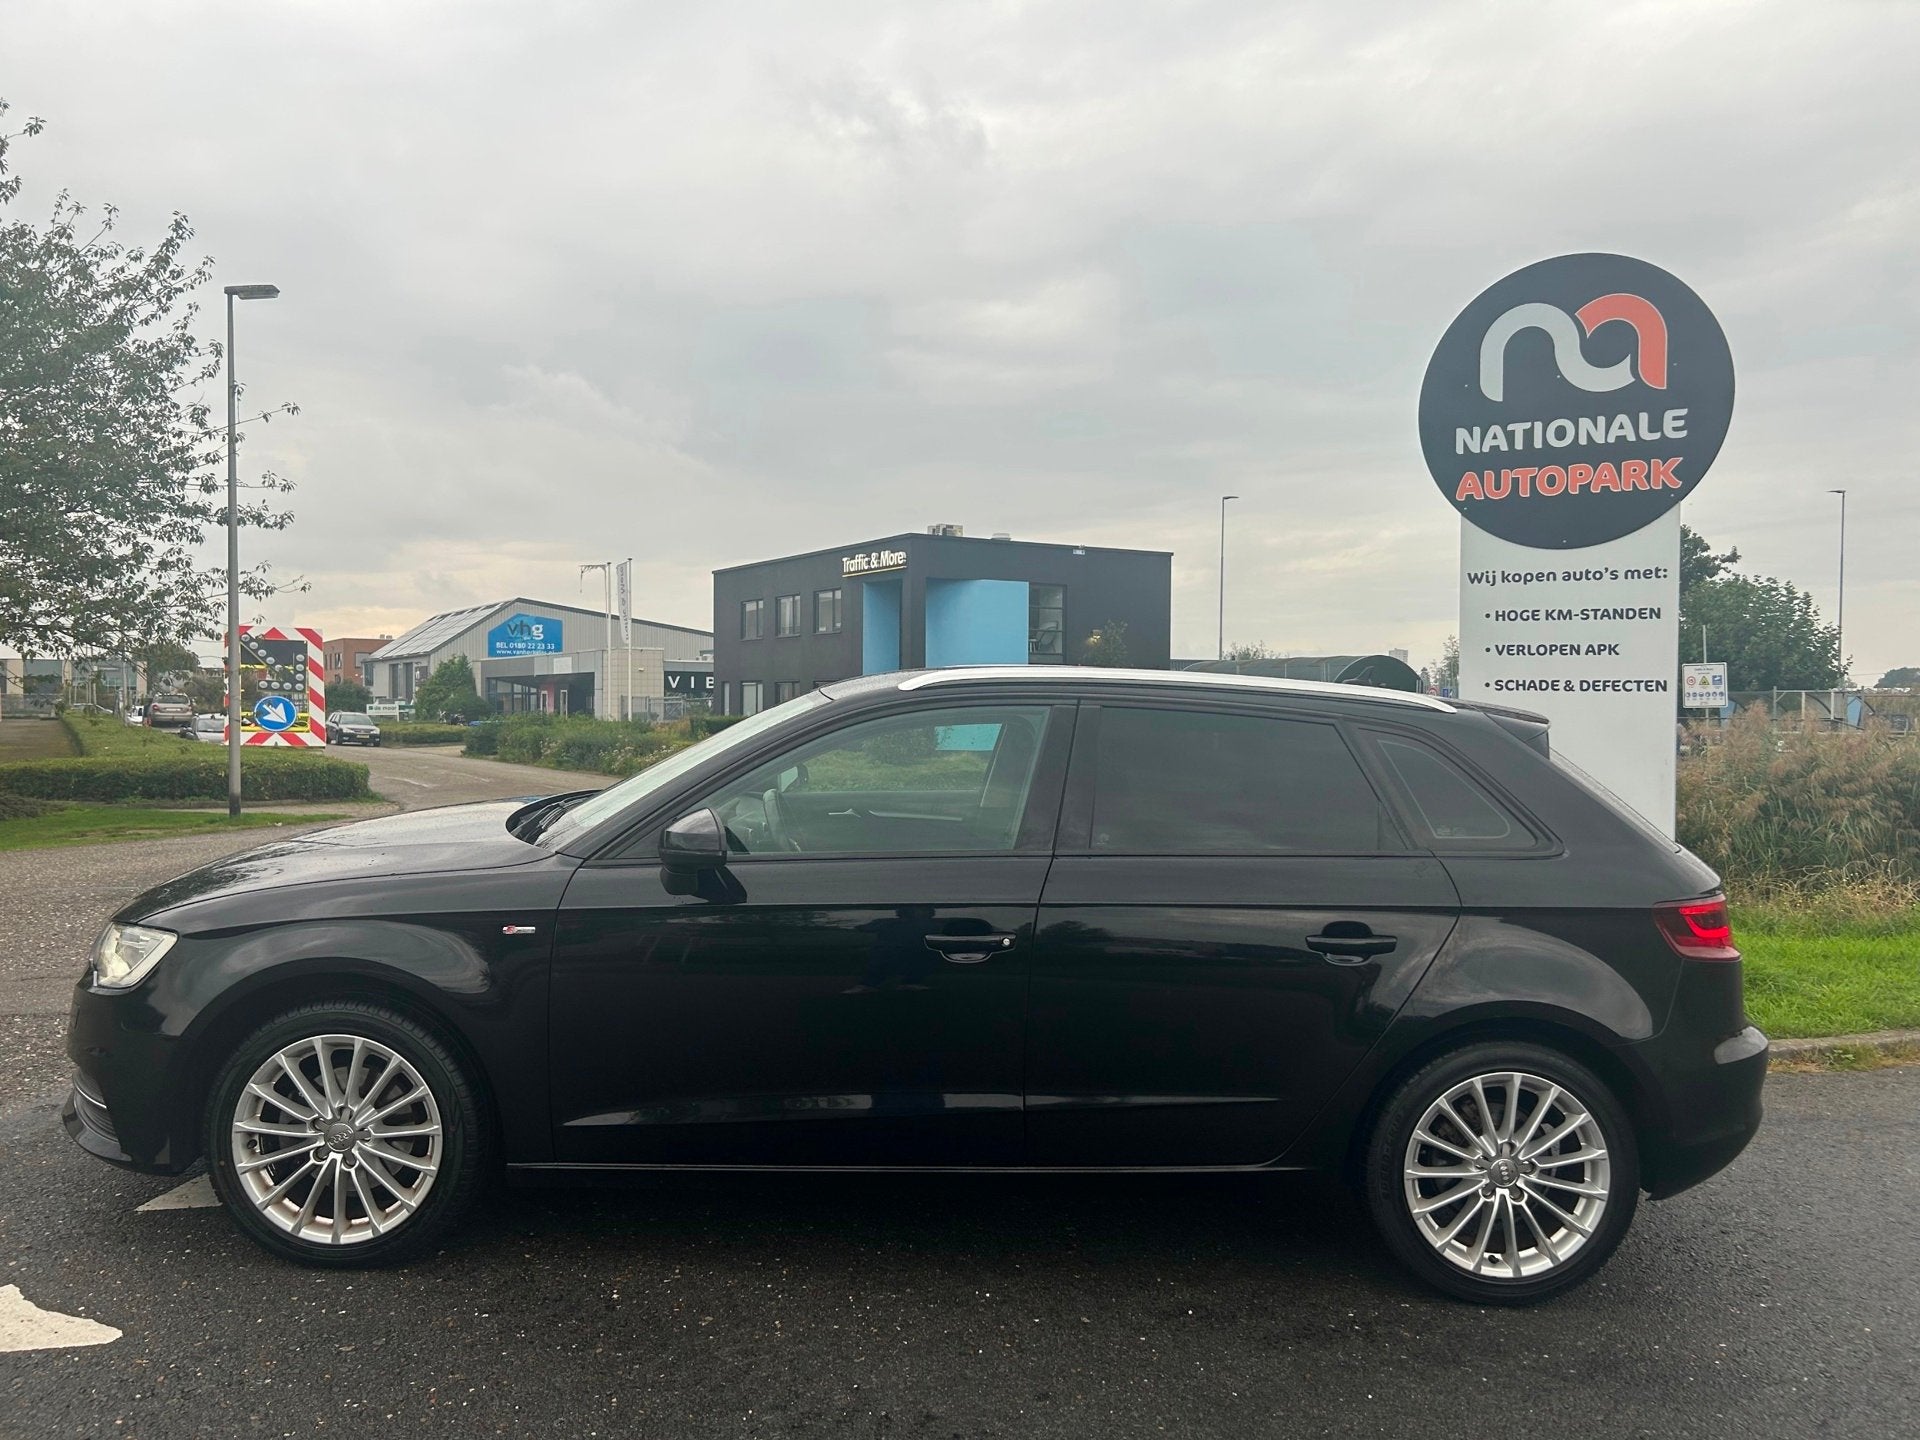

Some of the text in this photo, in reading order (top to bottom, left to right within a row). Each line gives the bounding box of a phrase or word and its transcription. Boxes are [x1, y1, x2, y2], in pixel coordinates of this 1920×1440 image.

[1455, 408, 1688, 455] NATIONALE
[1455, 457, 1683, 501] AUTOPARK
[842, 550, 907, 573] Traffic & More
[1467, 566, 1668, 586] Wij kopen auto's met:
[1495, 607, 1662, 622] HOGE KM-STANDEN
[507, 620, 544, 640] vhg
[1495, 644, 1620, 656] VERLOPEN APK
[1494, 680, 1667, 692] SCHADE & DEFECTEN
